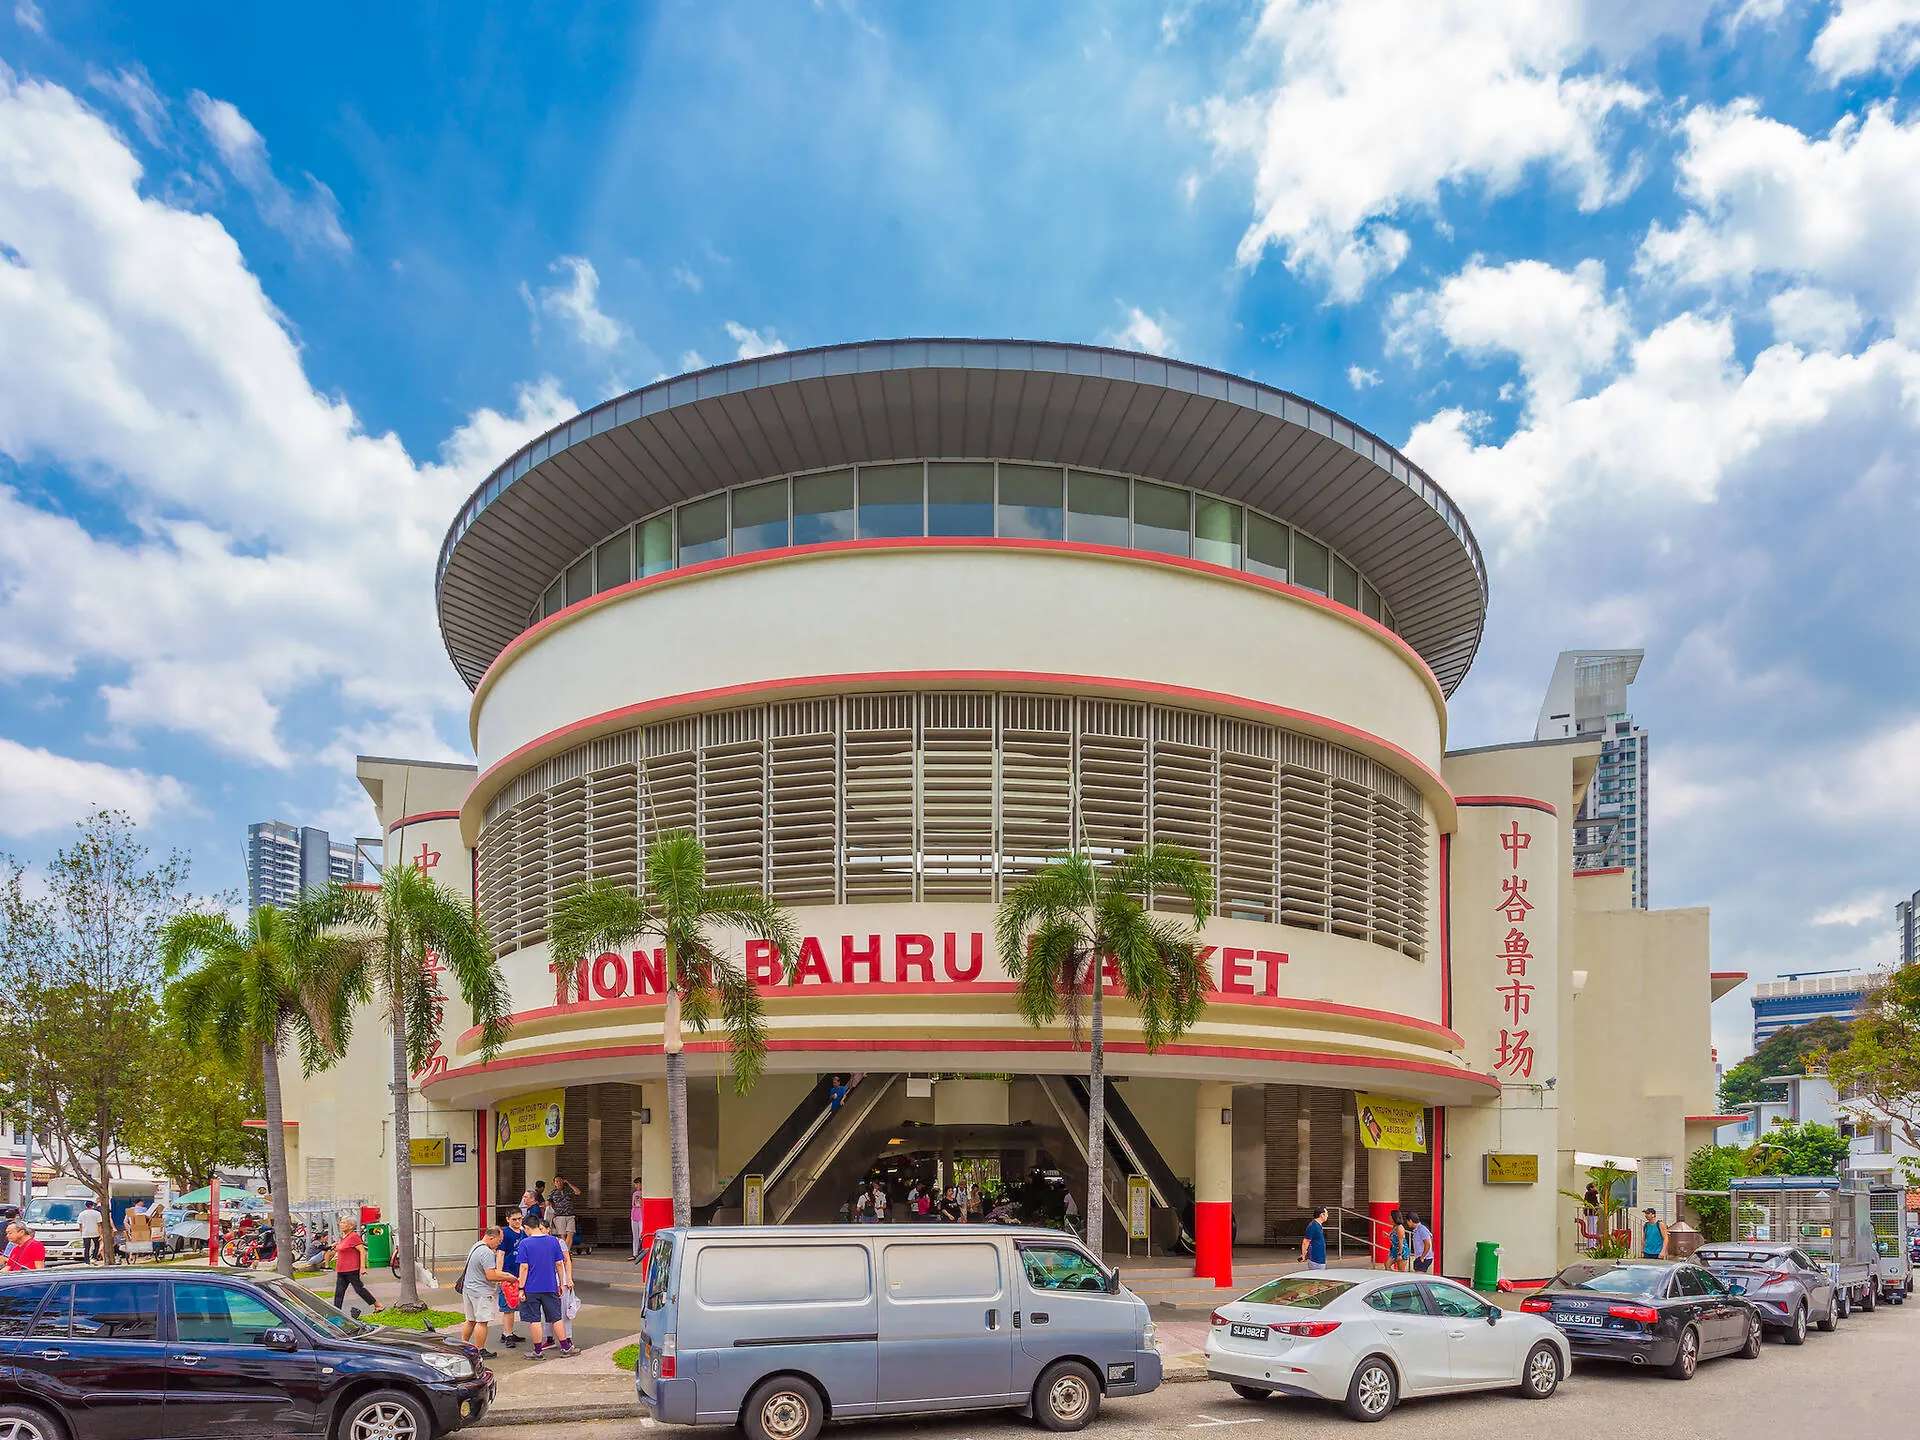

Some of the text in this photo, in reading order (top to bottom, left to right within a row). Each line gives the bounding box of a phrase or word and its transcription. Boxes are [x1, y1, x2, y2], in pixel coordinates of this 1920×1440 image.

[745, 931, 983, 985] BAHRU
[1493, 820, 1535, 1078] 中峇鲁市场
